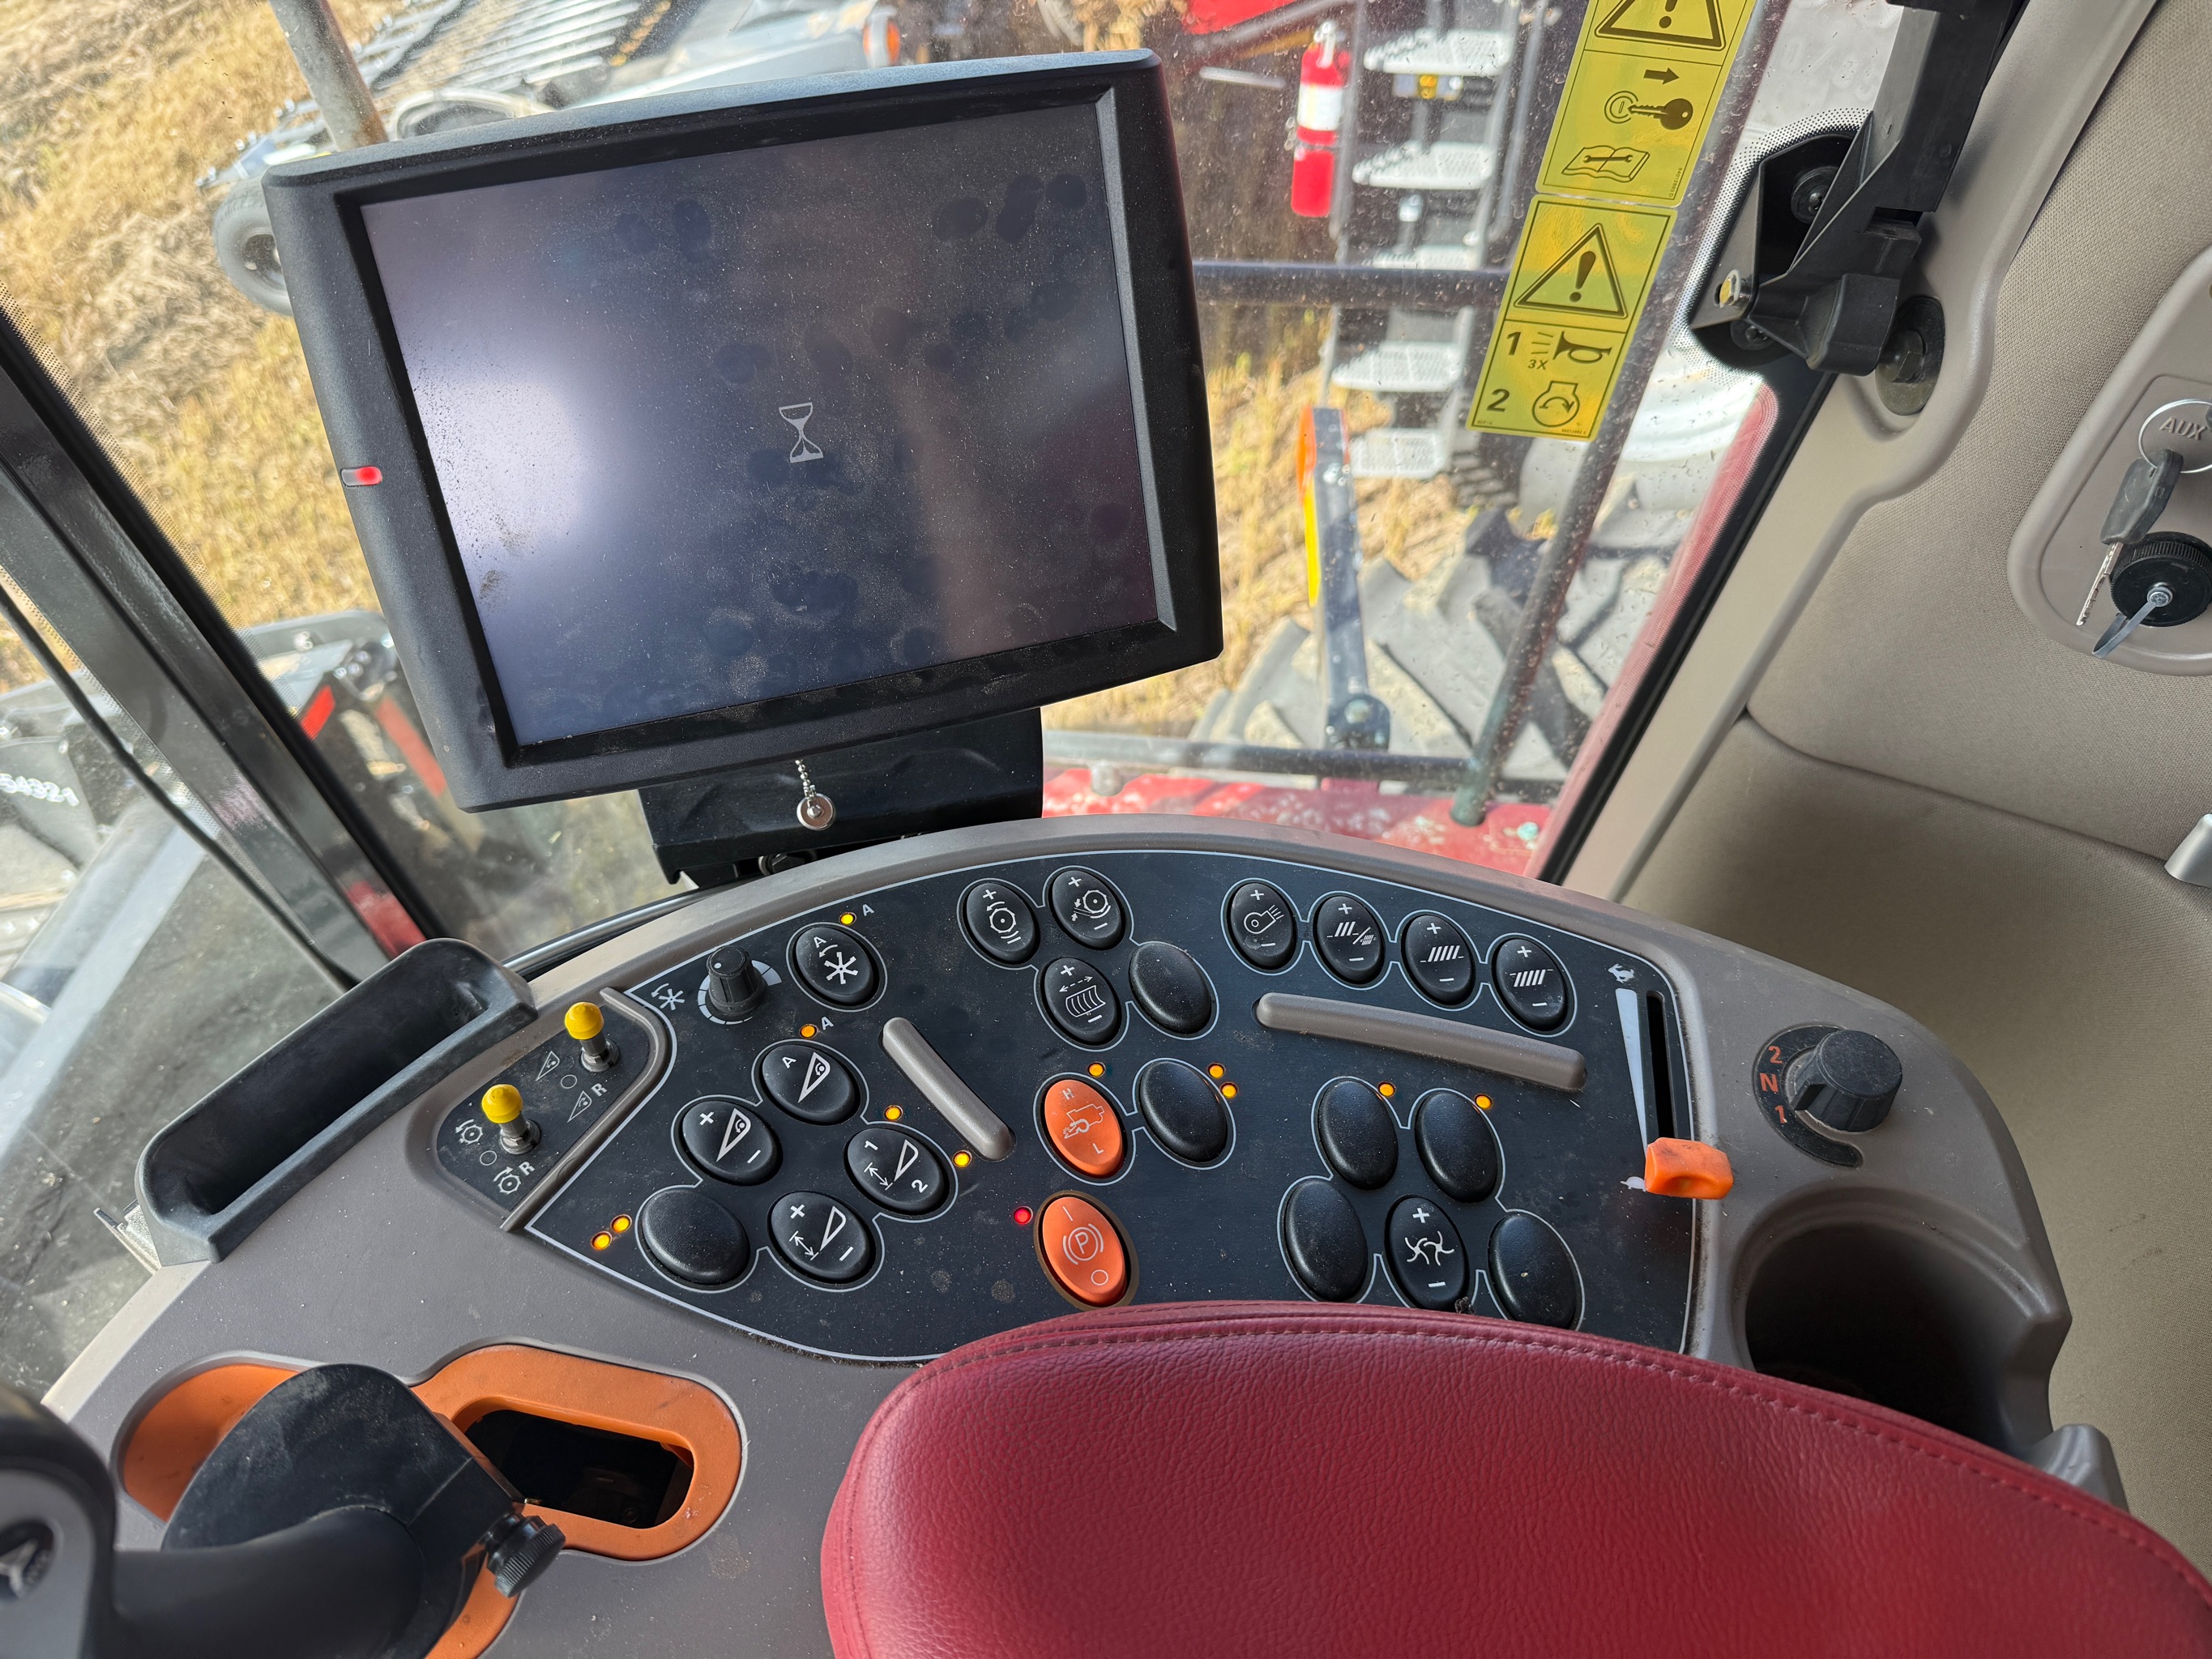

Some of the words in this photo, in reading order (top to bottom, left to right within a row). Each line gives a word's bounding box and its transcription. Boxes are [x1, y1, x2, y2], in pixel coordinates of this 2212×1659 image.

[1506, 331, 1522, 356] 1
[1527, 359, 1548, 371] 3X
[1486, 388, 1510, 413] 2
[2159, 416, 2207, 440] AUX
[862, 903, 875, 916] A
[813, 936, 827, 949] A
[821, 1016, 835, 1030] A
[1768, 1046, 1783, 1064] 2
[782, 1056, 796, 1069] A
[591, 1082, 608, 1097] R
[1759, 1073, 1779, 1093] N
[1062, 1088, 1074, 1100] H
[1774, 1105, 1786, 1124] 1
[865, 1140, 878, 1151] 1
[1092, 1143, 1104, 1154] L
[519, 1161, 536, 1176] R
[911, 1179, 929, 1193] 2
[1074, 1231, 1089, 1254] P
